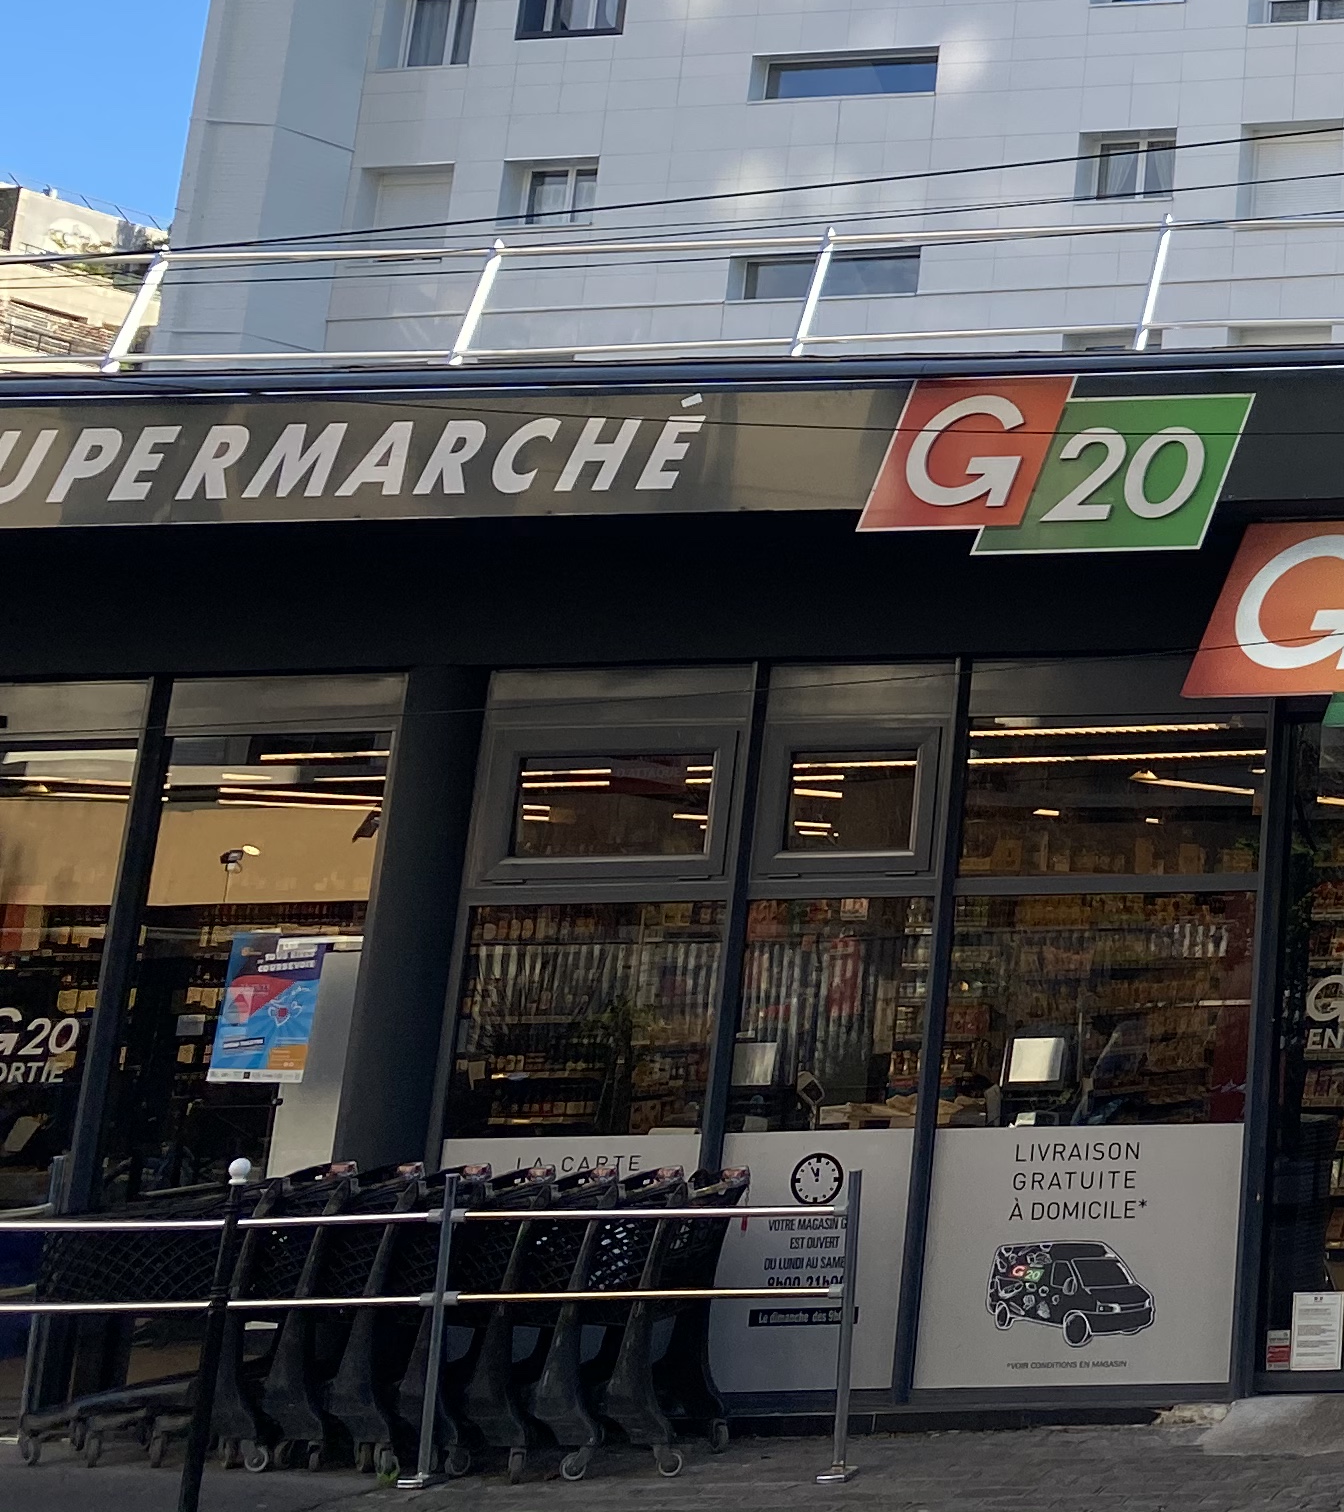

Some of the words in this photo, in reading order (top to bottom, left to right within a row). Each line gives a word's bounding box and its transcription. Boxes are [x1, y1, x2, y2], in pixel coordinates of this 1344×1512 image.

[1015, 1141, 1141, 1162] LIVRAISON
[1012, 1170, 1137, 1191] GRATUITE
[1009, 1198, 1024, 1221] À
[768, 1219, 796, 1231] VOTRE
[797, 1218, 839, 1230] MAGASIN
[790, 1237, 804, 1249] EST
[806, 1236, 840, 1248] OUVERT
[764, 1258, 777, 1270] DU
[778, 1257, 805, 1270] LUNDI
[805, 1257, 819, 1269] AU
[820, 1256, 846, 1269] SAME
